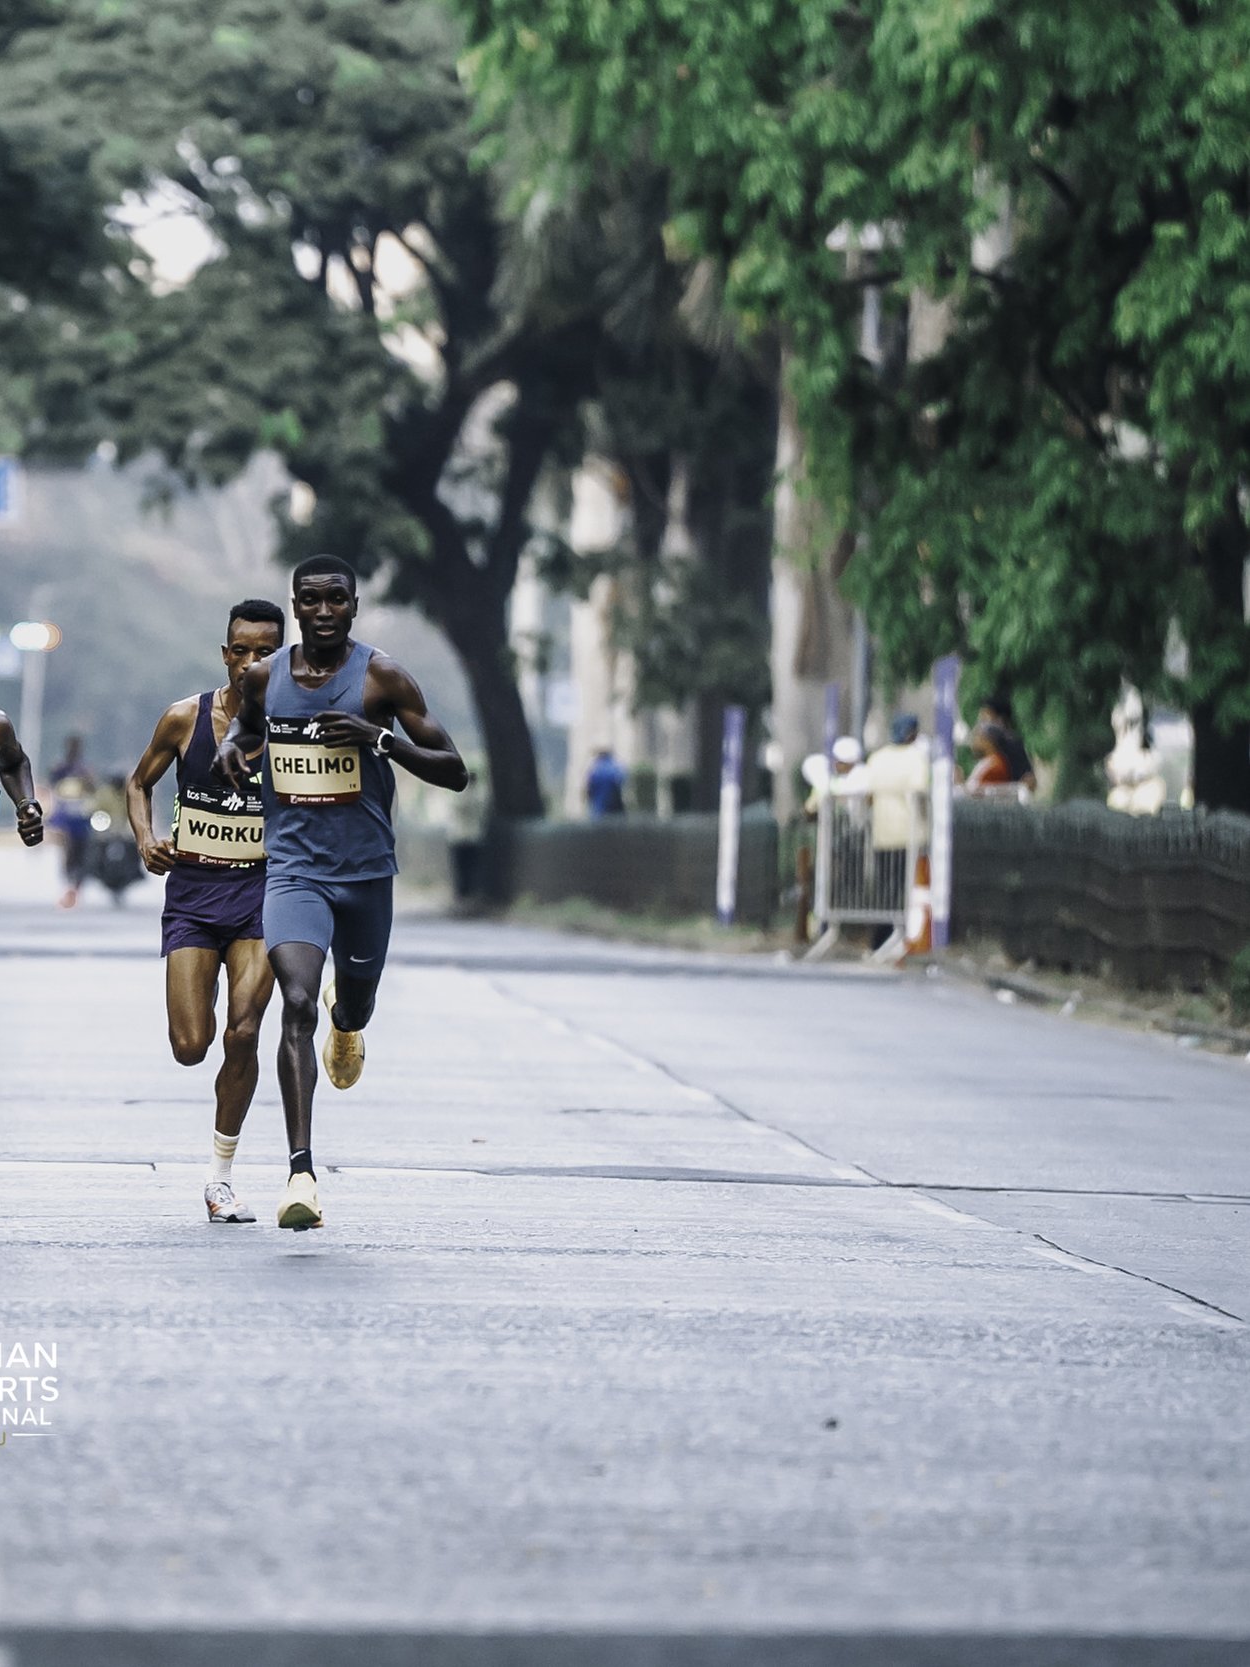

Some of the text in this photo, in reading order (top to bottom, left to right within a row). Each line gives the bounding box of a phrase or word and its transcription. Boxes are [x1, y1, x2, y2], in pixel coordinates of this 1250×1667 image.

[274, 756, 355, 774] CHELIMO
[187, 789, 200, 801] tcs
[188, 819, 263, 843] WORKU
